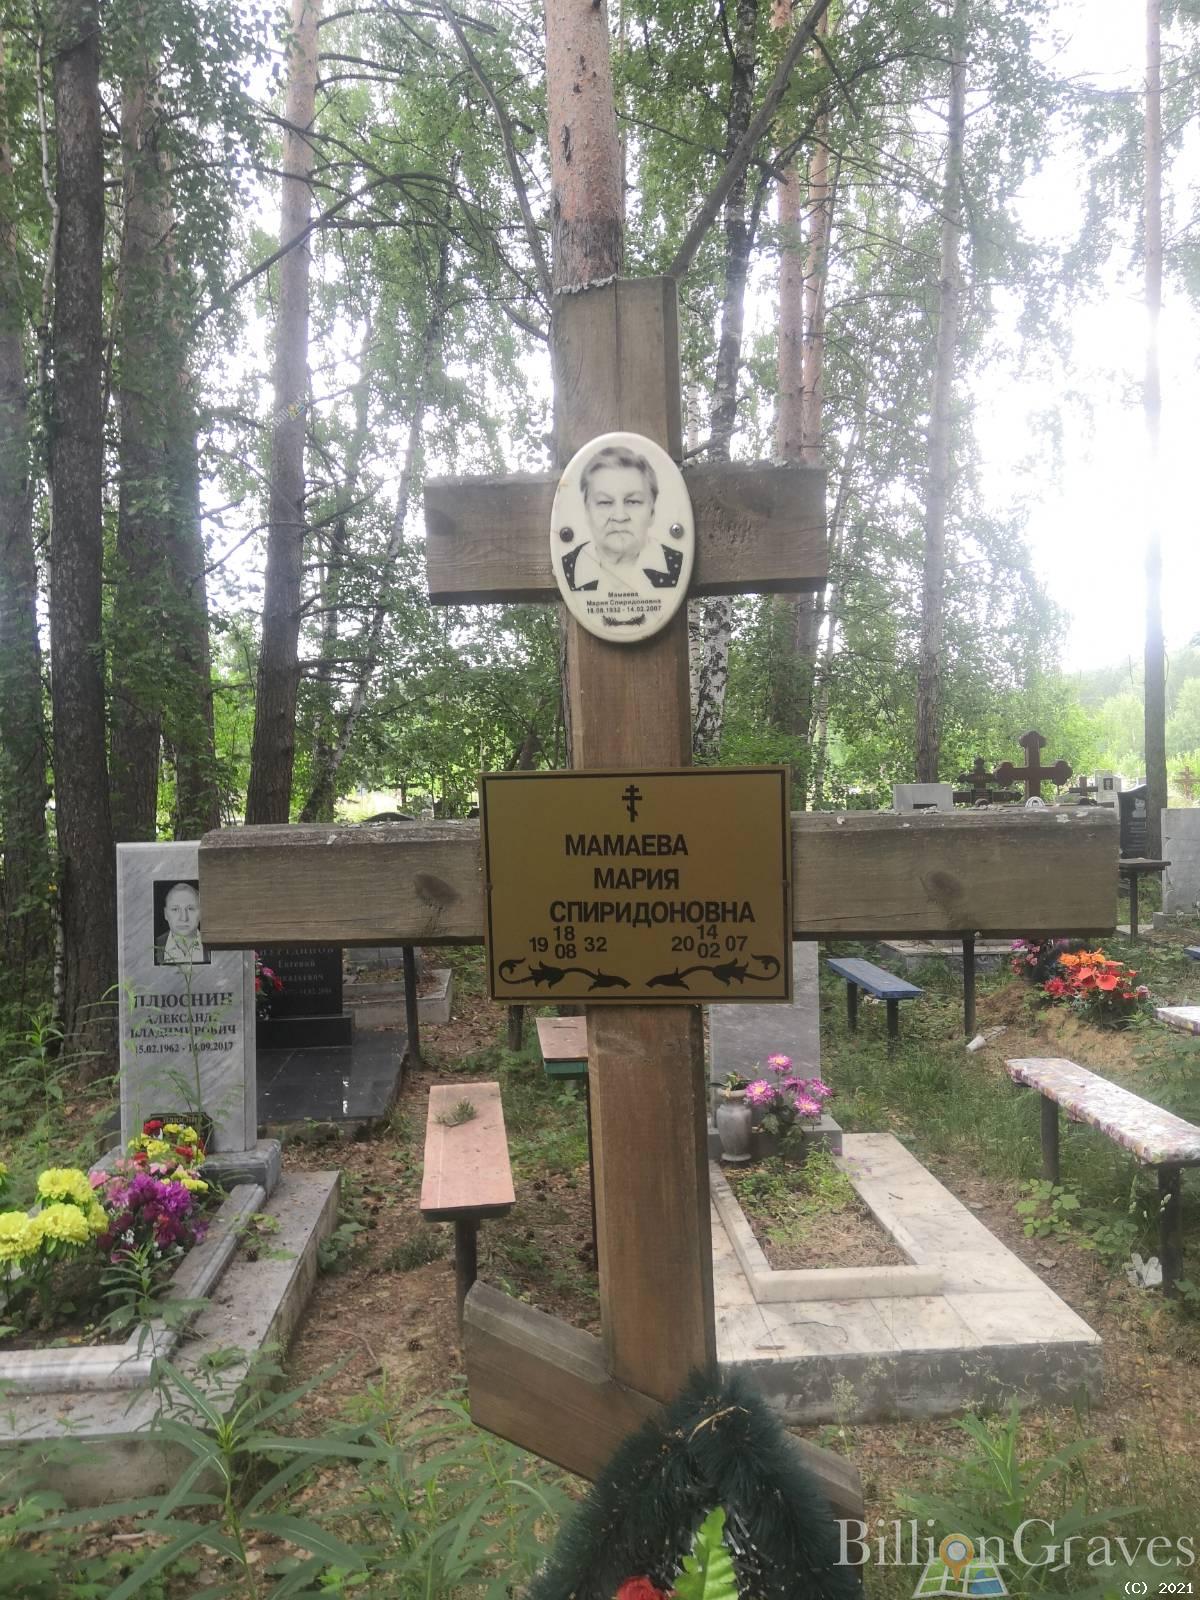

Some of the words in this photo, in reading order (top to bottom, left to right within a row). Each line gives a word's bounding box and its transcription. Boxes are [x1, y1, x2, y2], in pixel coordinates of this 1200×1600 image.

[565, 833, 689, 857] МАМАЕВА
[593, 867, 680, 890] МАРИЯ
[549, 900, 756, 929] СПИРИДОНОВНА
[553, 926, 575, 942] 18
[697, 924, 719, 940] 14
[528, 936, 549, 953] 19
[583, 936, 608, 953] 32
[554, 943, 577, 959] 08
[671, 935, 694, 952] 20
[725, 935, 748, 952] 07
[697, 942, 721, 959] 02
